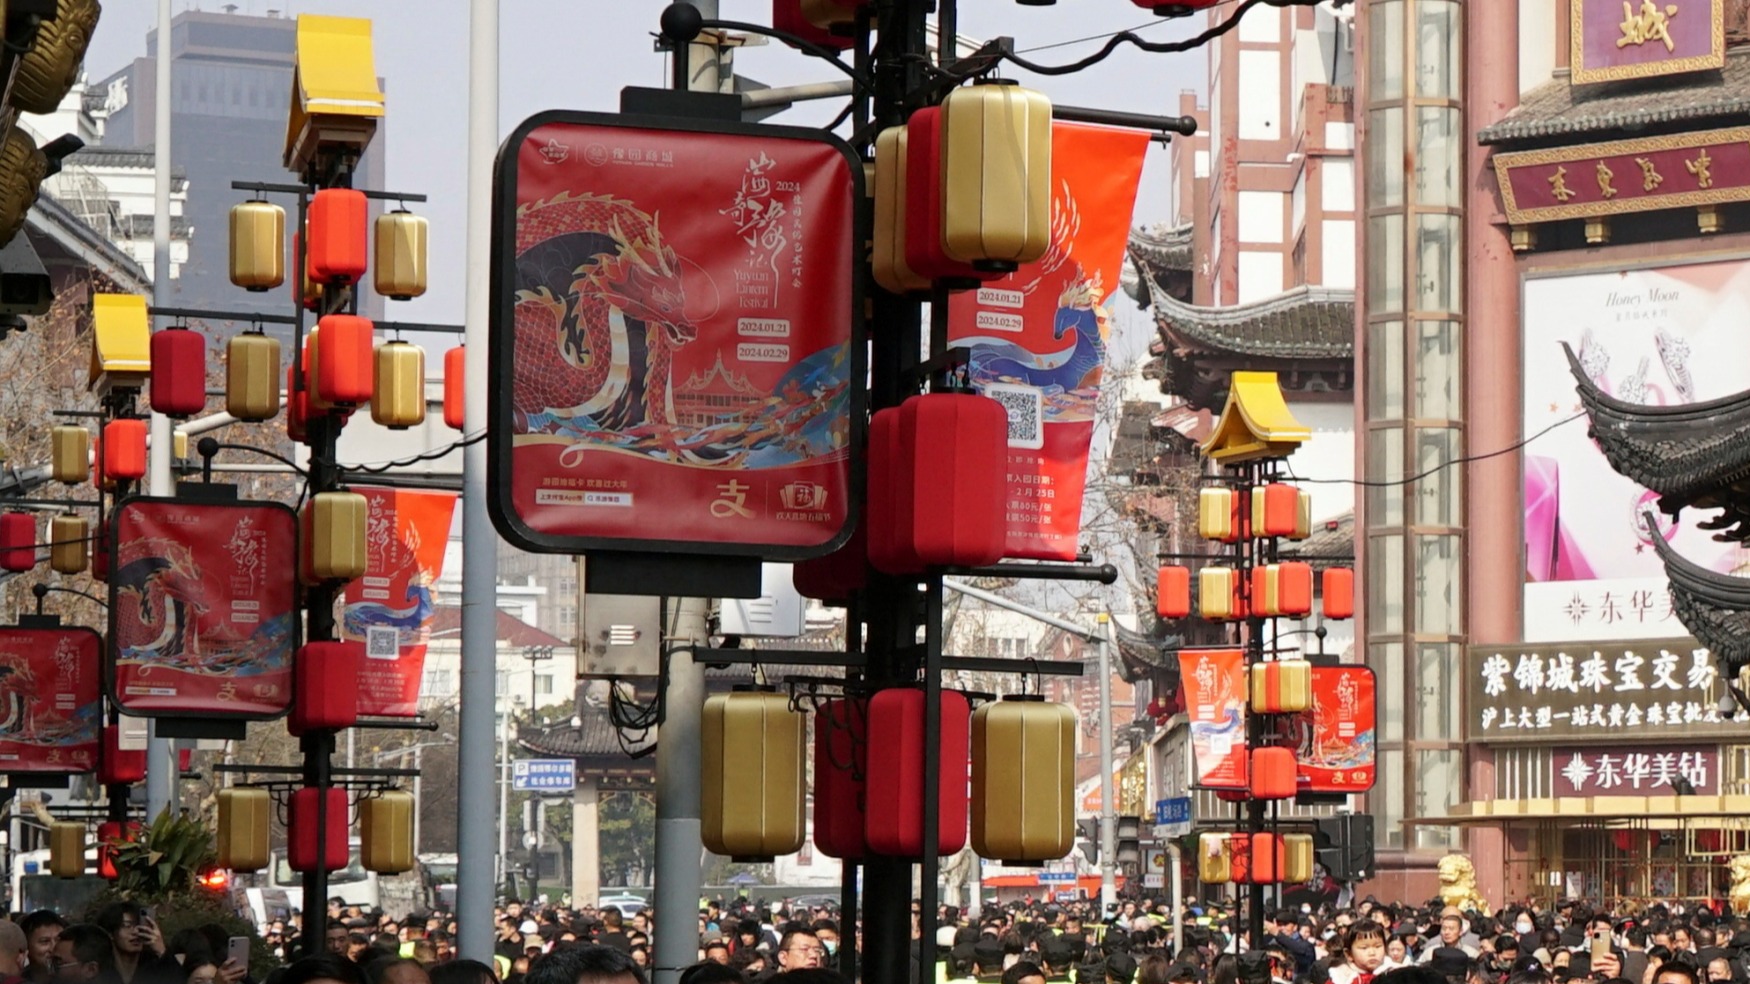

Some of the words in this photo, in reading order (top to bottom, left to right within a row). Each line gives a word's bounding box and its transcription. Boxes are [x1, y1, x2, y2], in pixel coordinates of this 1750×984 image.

[775, 180, 801, 192] 2024
[979, 290, 1023, 306] 2024.01.21
[1606, 292, 1642, 309] Honey
[1649, 287, 1680, 303] Moon
[740, 321, 787, 333] 2024.01.21
[978, 314, 1023, 331] 2024.02.29
[739, 347, 788, 359] 2024.02.29
[1481, 648, 1716, 697] 紫锦城珠宝交易
[1595, 752, 1707, 789] 东华美钻
